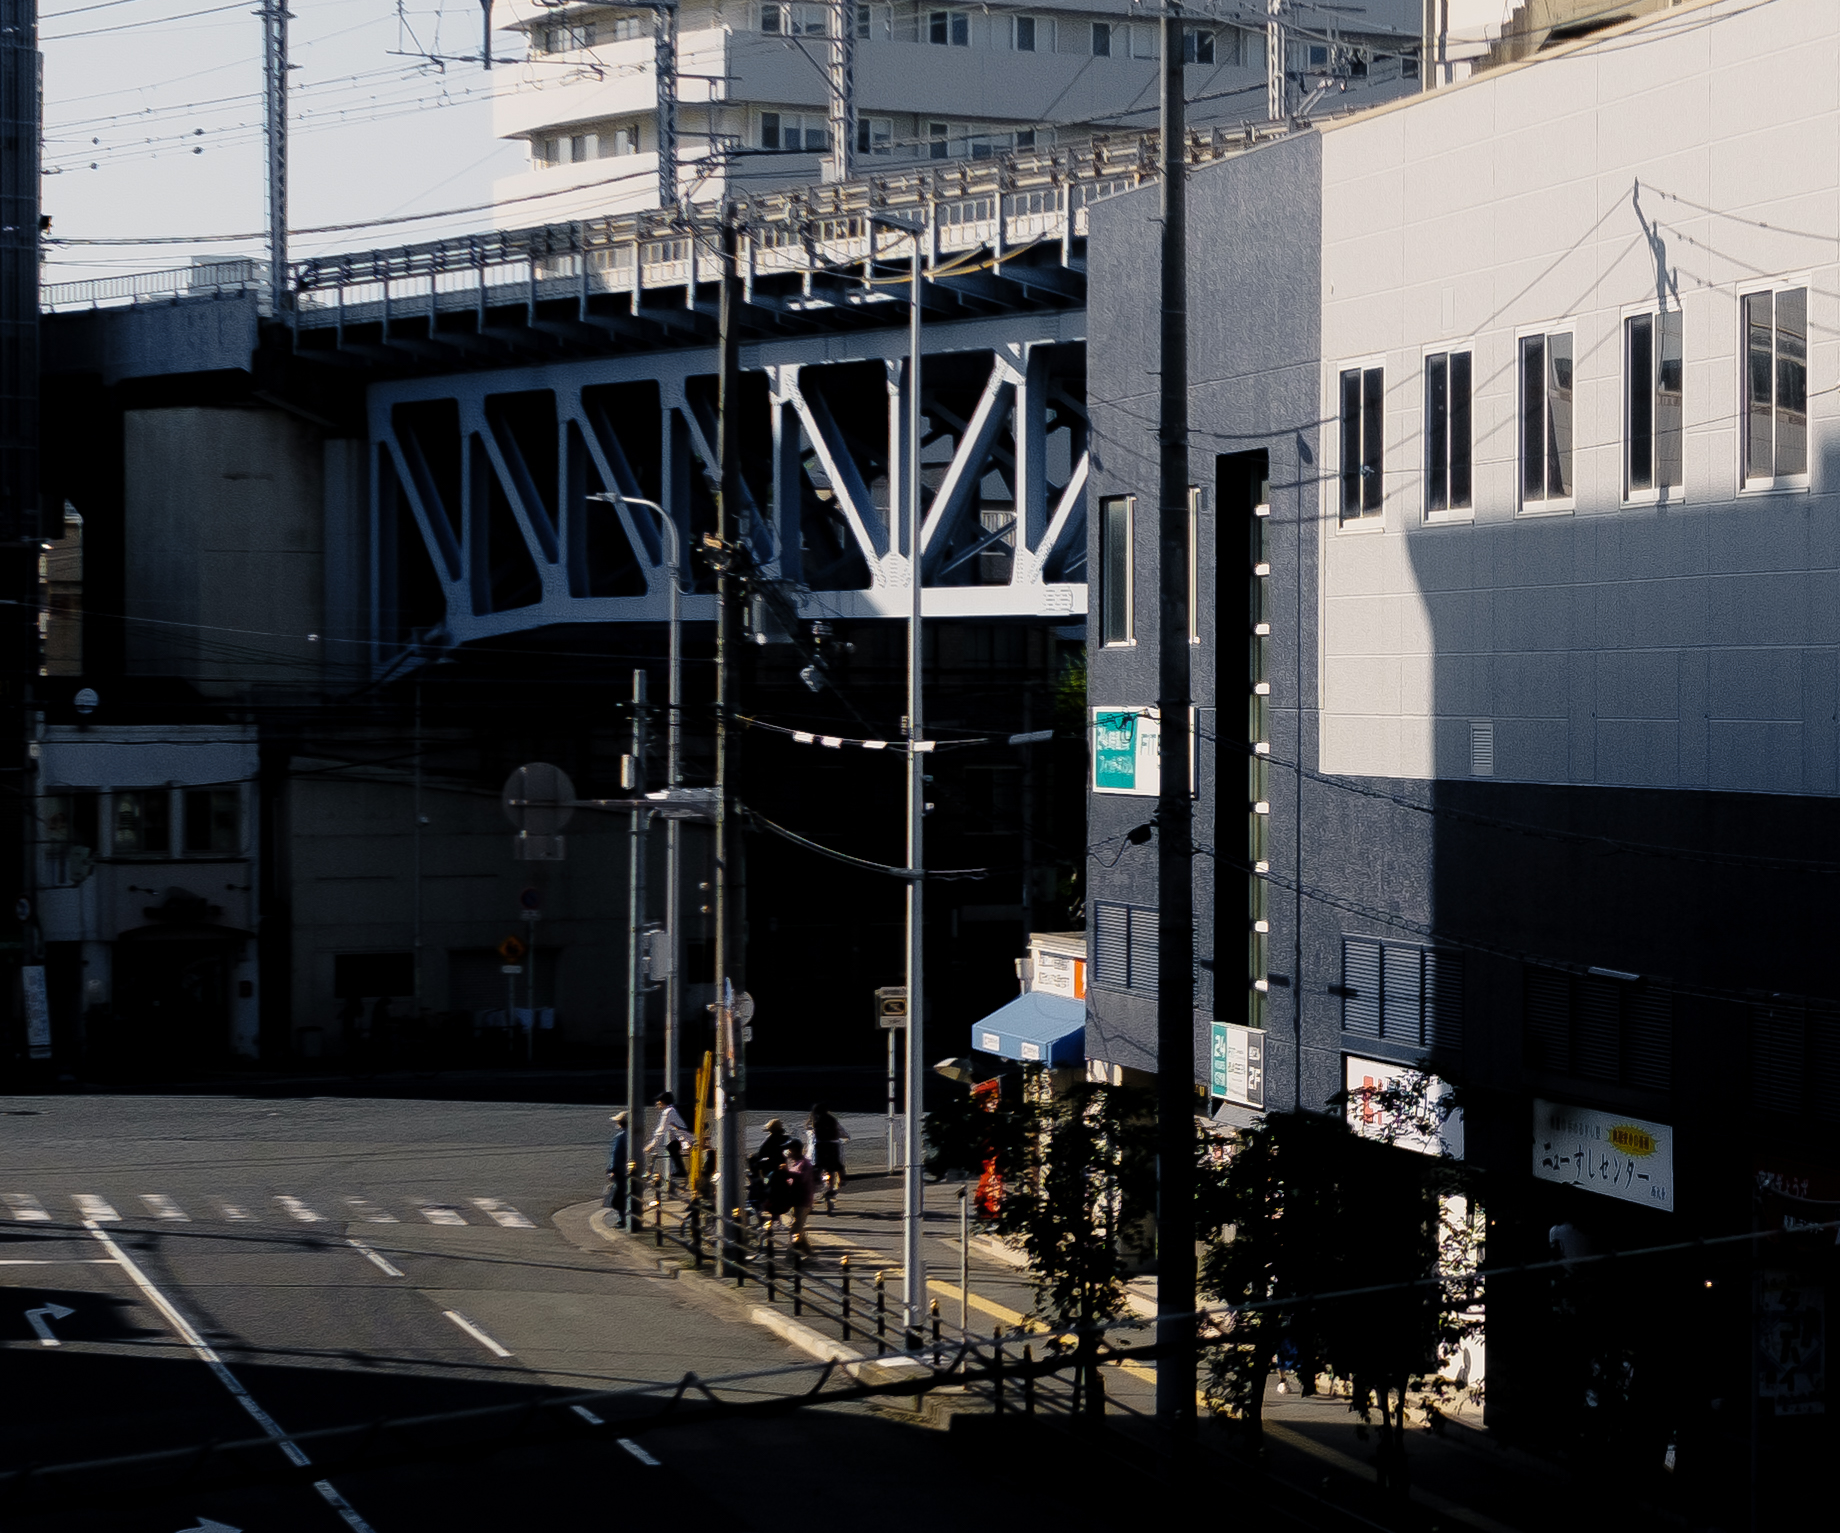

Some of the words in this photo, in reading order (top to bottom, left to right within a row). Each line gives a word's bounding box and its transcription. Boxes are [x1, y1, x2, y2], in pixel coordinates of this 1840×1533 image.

[1542, 1142, 1650, 1189] ニューすしセンター
